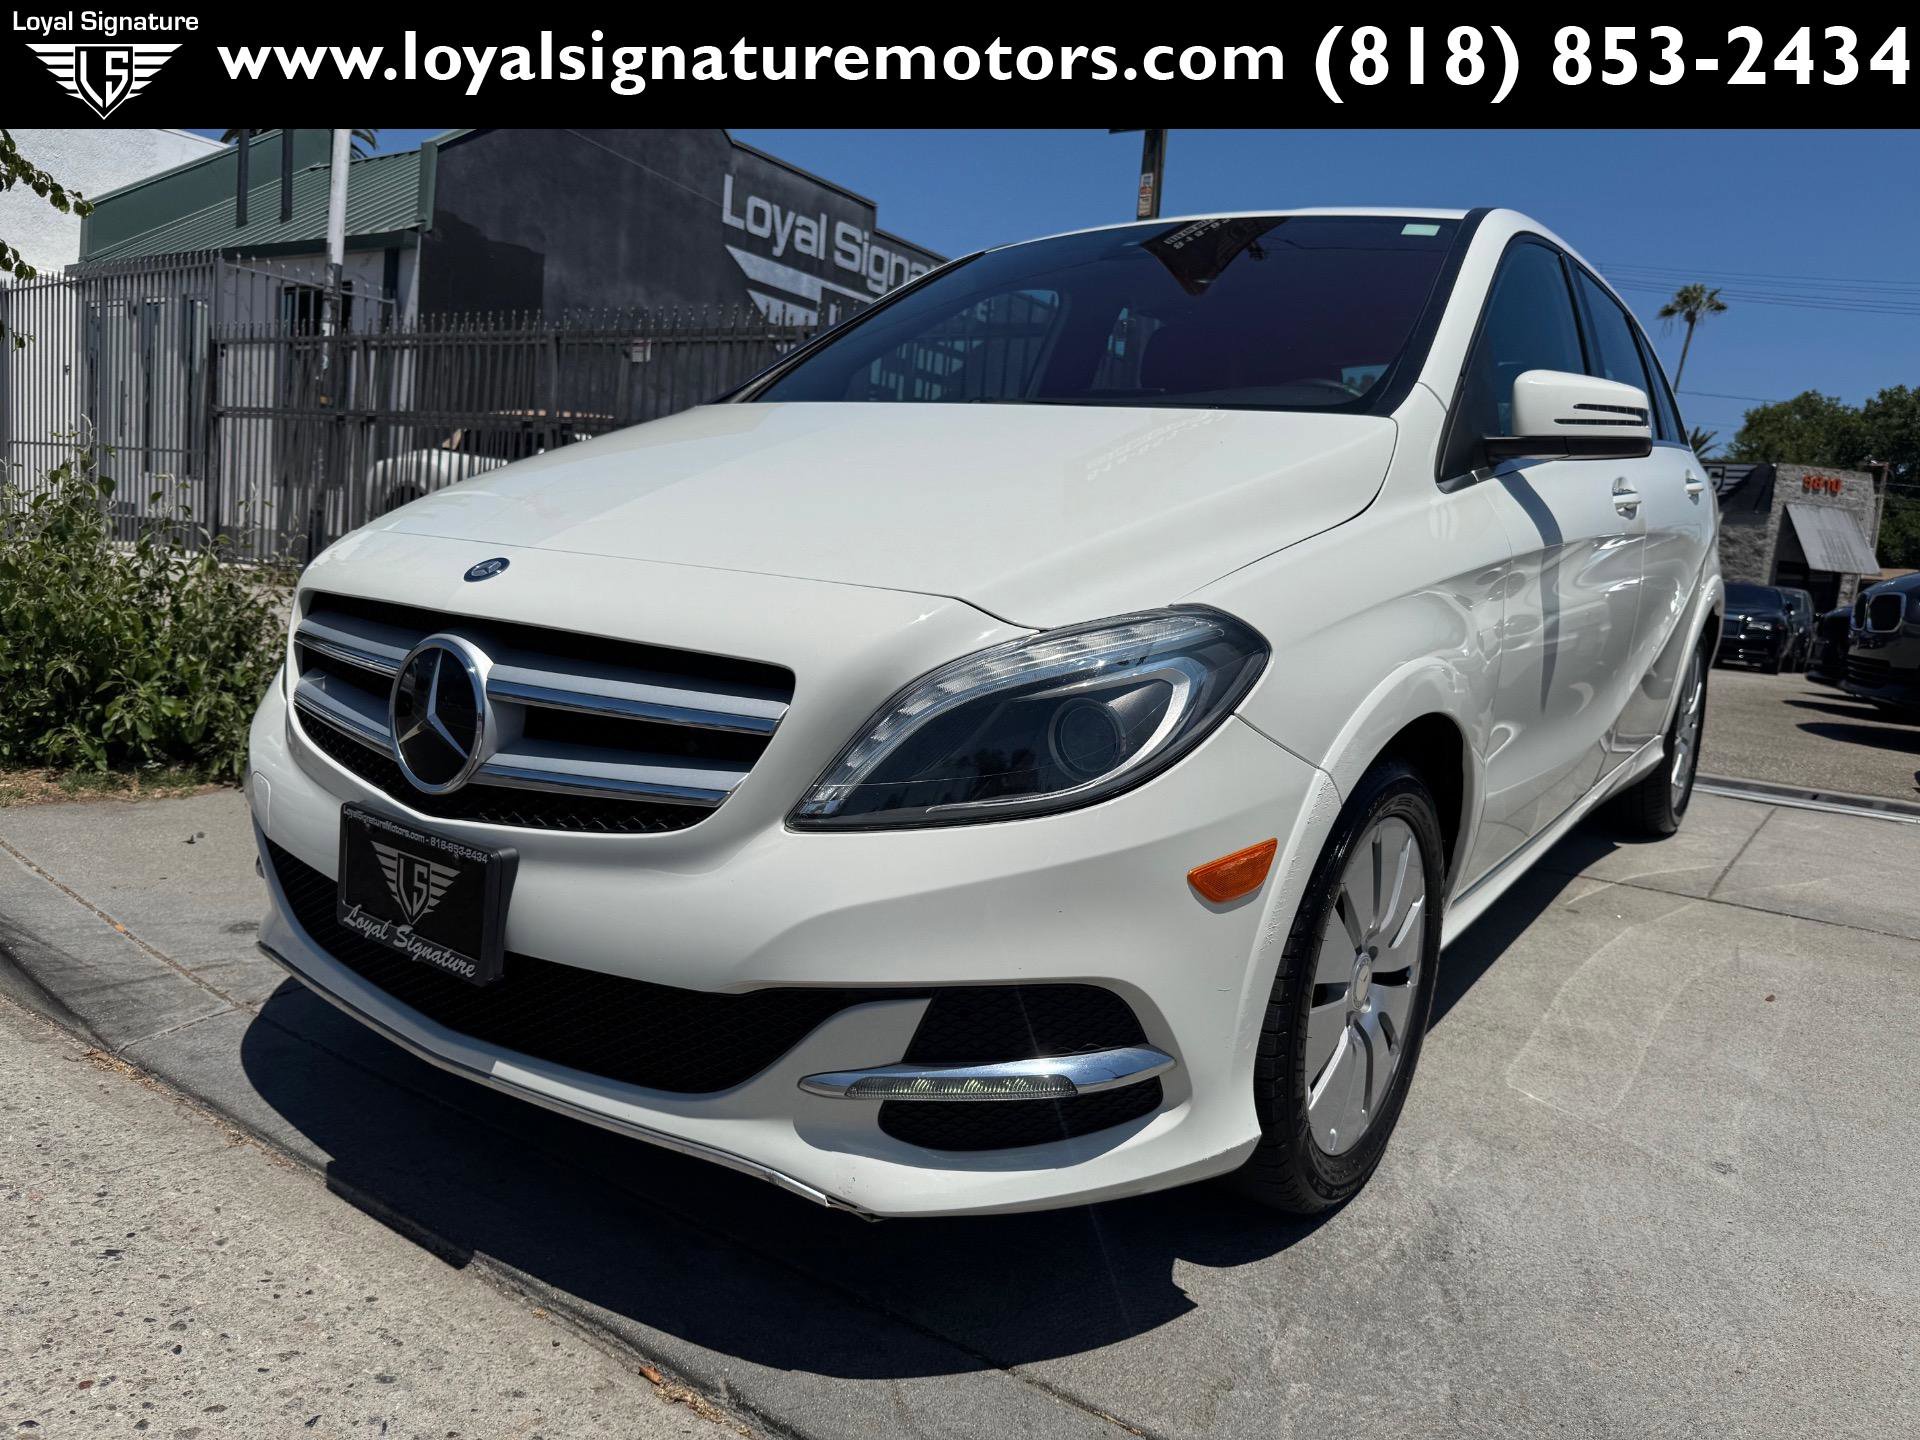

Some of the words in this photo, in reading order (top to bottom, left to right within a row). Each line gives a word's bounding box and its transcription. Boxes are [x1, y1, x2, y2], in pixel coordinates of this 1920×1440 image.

[722, 173, 828, 261] Loyal
[343, 903, 393, 940] Loyal
[393, 924, 477, 978] Signature
